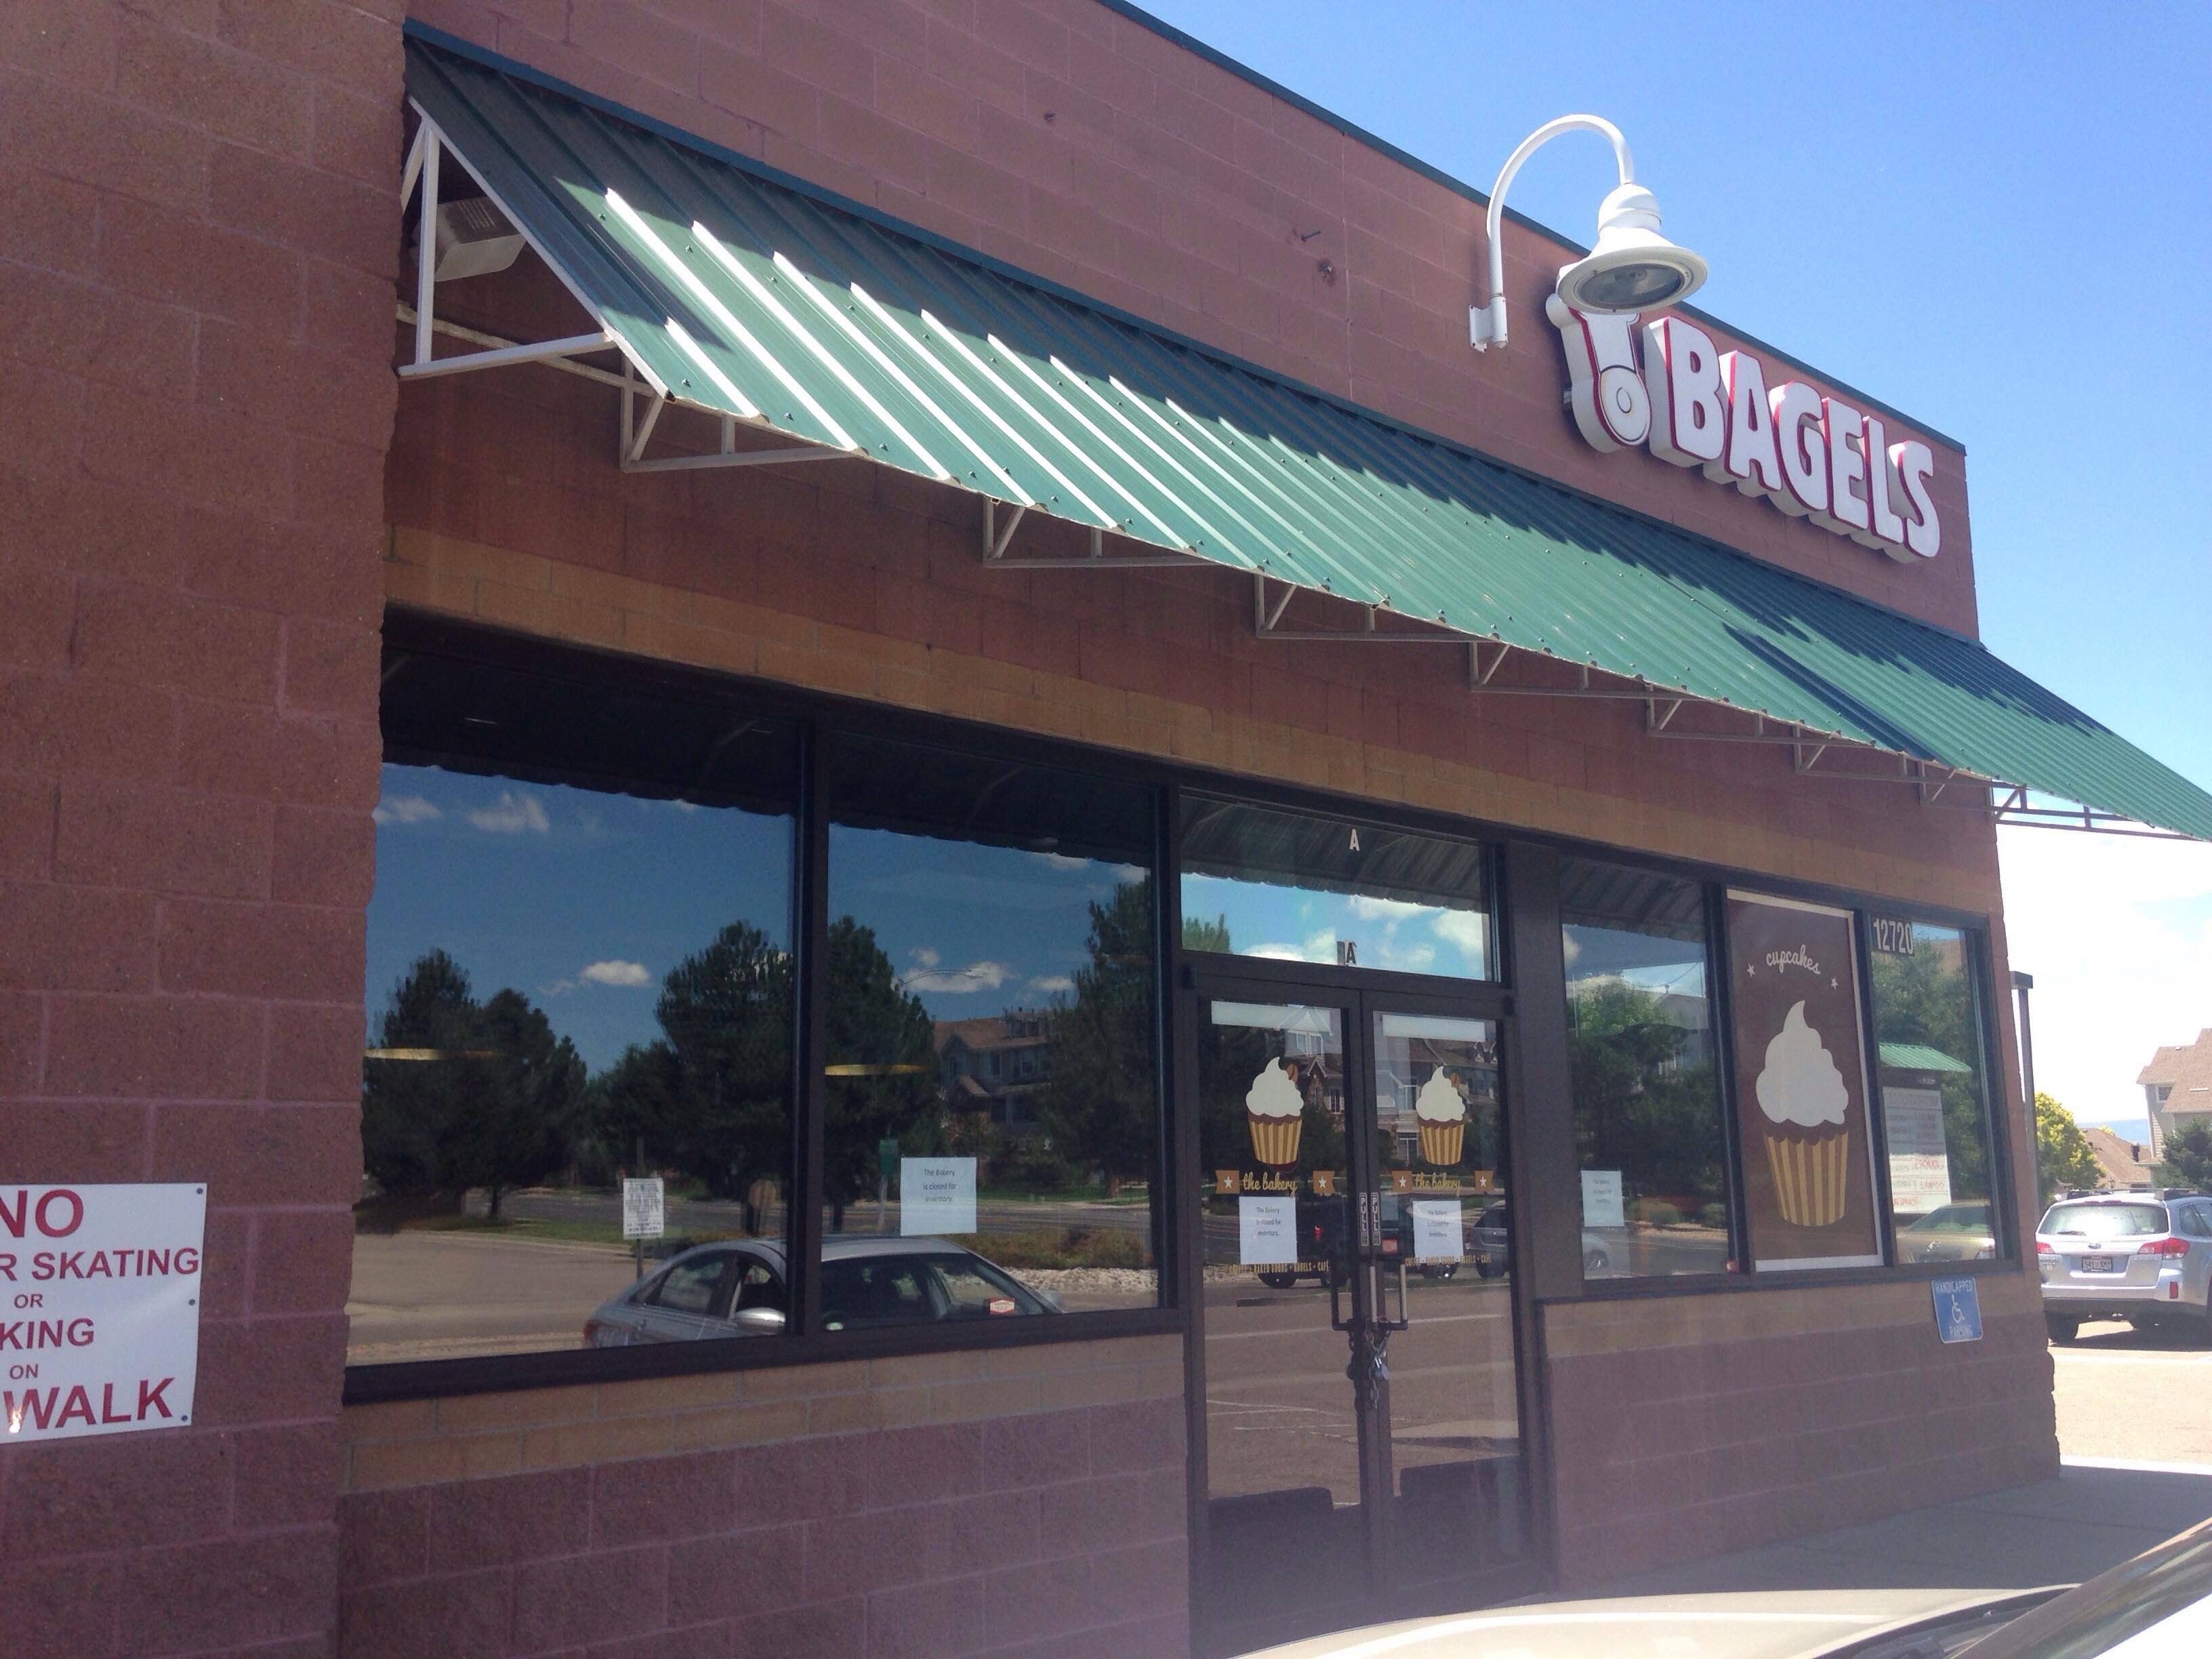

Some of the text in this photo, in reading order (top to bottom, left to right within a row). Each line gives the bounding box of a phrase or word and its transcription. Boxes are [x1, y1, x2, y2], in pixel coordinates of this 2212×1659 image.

[1654, 315, 1940, 561] BAGELS
[1349, 828, 1360, 851] A
[1873, 918, 1914, 955] 12720
[1765, 943, 1821, 975] cupcakes
[928, 1183, 947, 1191] closed
[1242, 1171, 1298, 1199] the bakery
[1414, 1171, 1461, 1197] the bakery
[0, 1189, 84, 1238] NO
[31, 1248, 199, 1280] SKATING
[14, 1293, 43, 1309] OR
[0, 1317, 95, 1351] KING
[9, 1364, 39, 1380] ON
[3, 1377, 175, 1430] WALK
